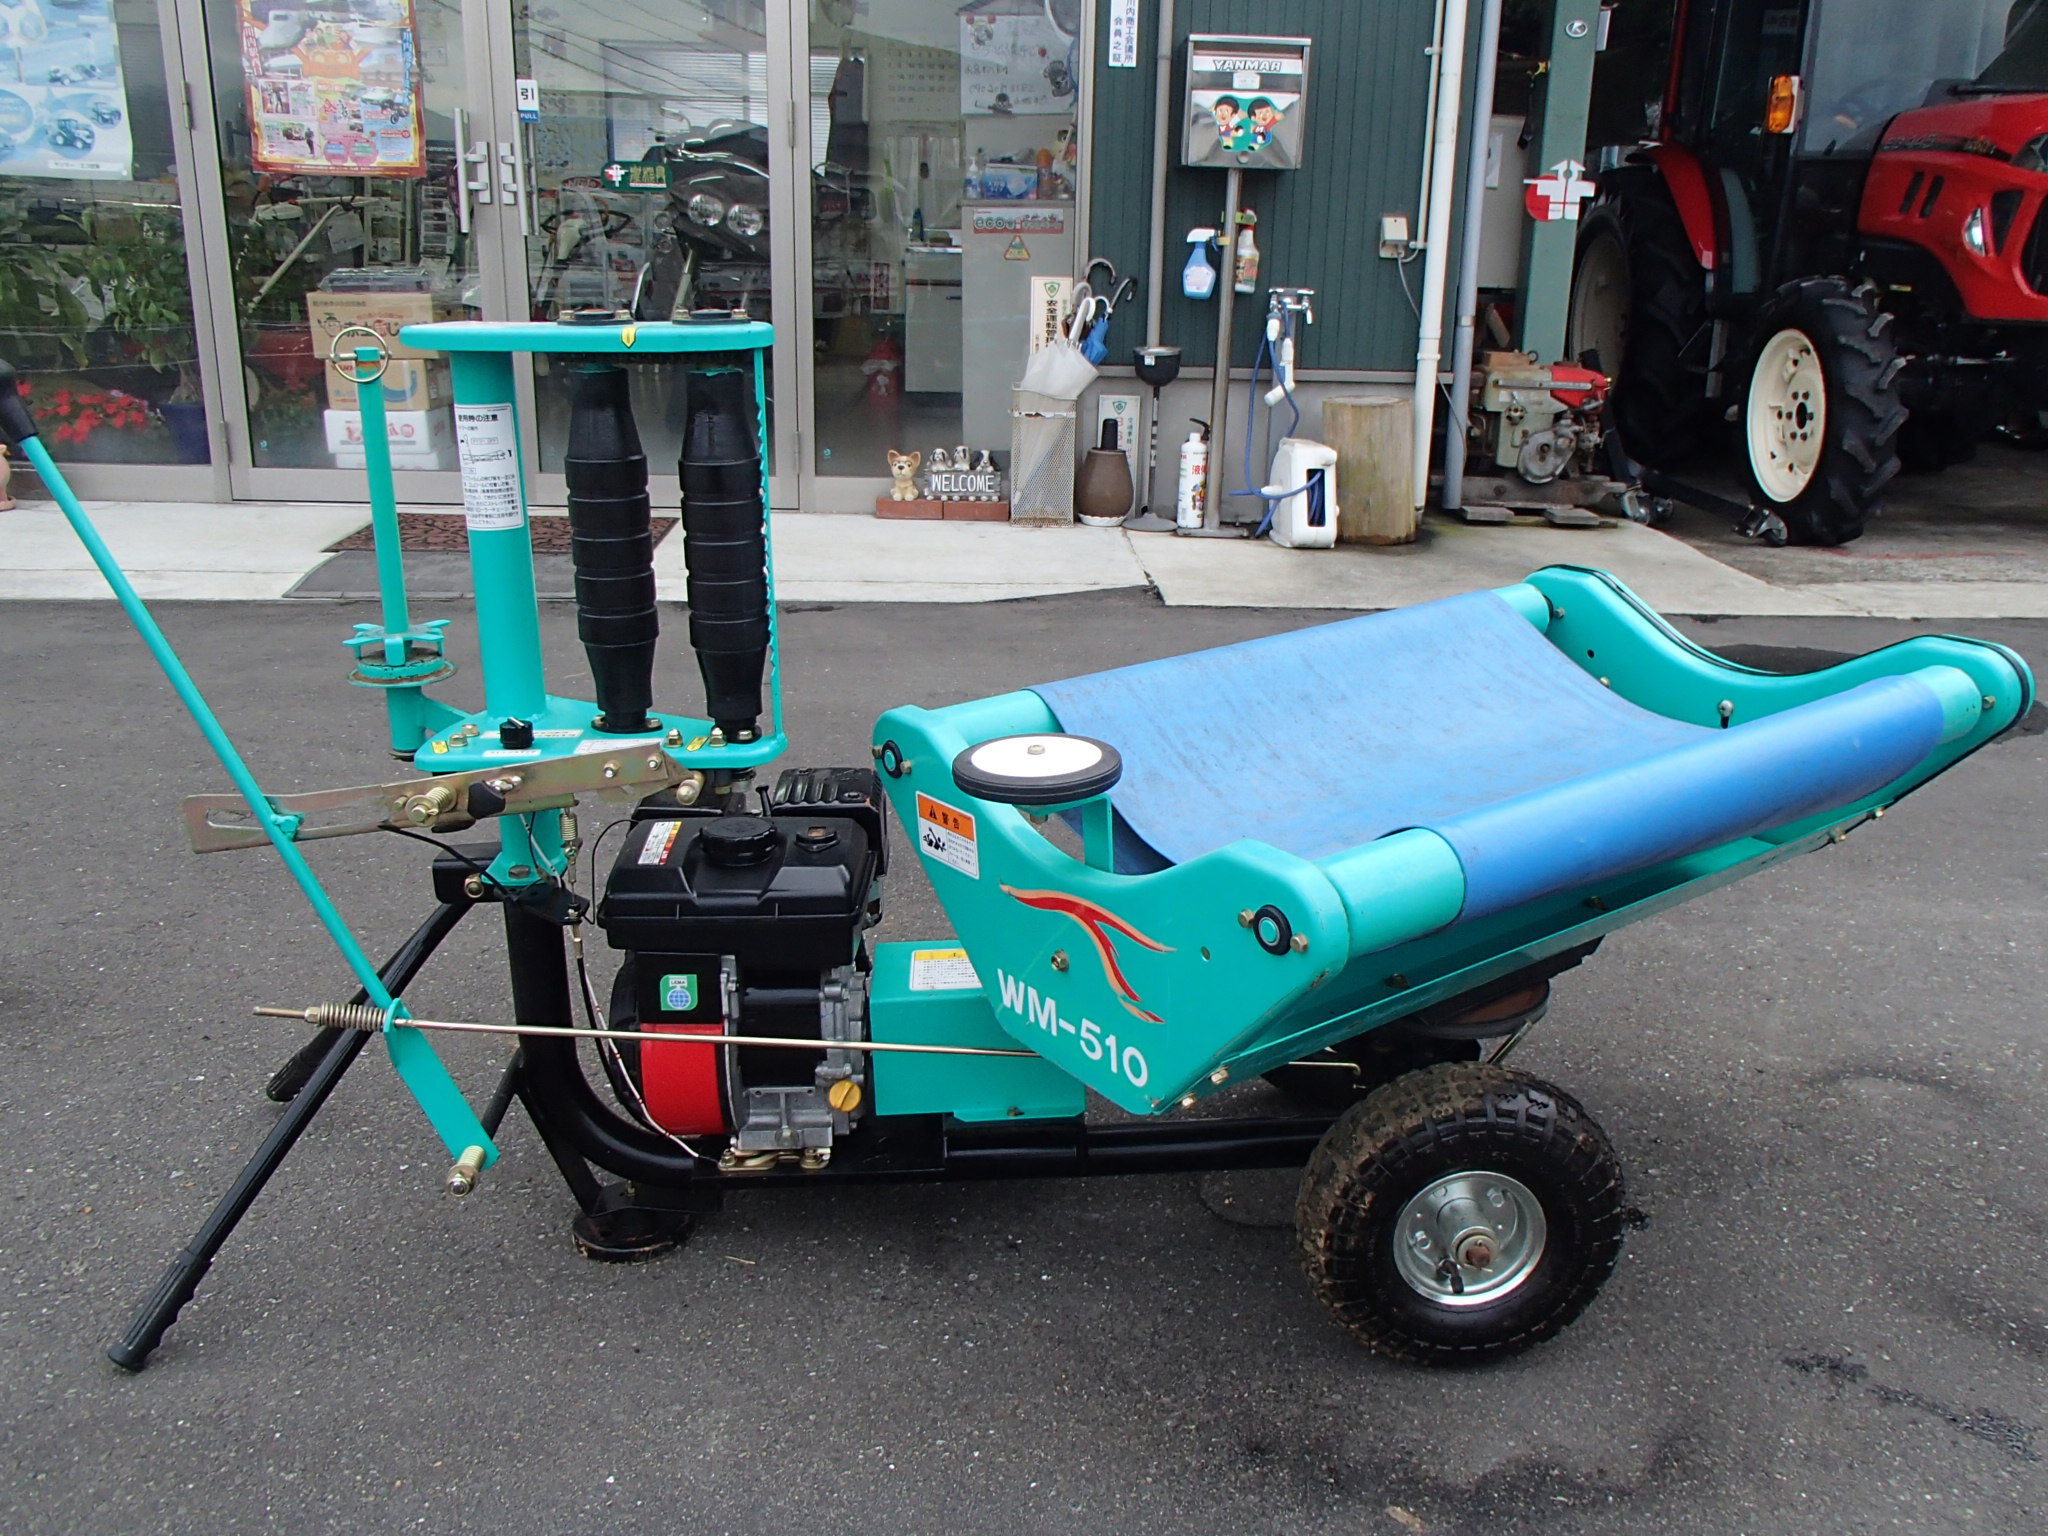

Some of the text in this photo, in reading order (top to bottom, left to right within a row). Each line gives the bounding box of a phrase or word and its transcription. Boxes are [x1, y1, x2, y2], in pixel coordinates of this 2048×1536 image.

[1213, 59, 1282, 72] YANMAR
[520, 87, 534, 101] 引
[1045, 299, 1058, 348] 安全運転管理
[931, 474, 994, 492] WELCOME
[942, 812, 959, 830] 警告
[997, 968, 1148, 1087] WM-510
